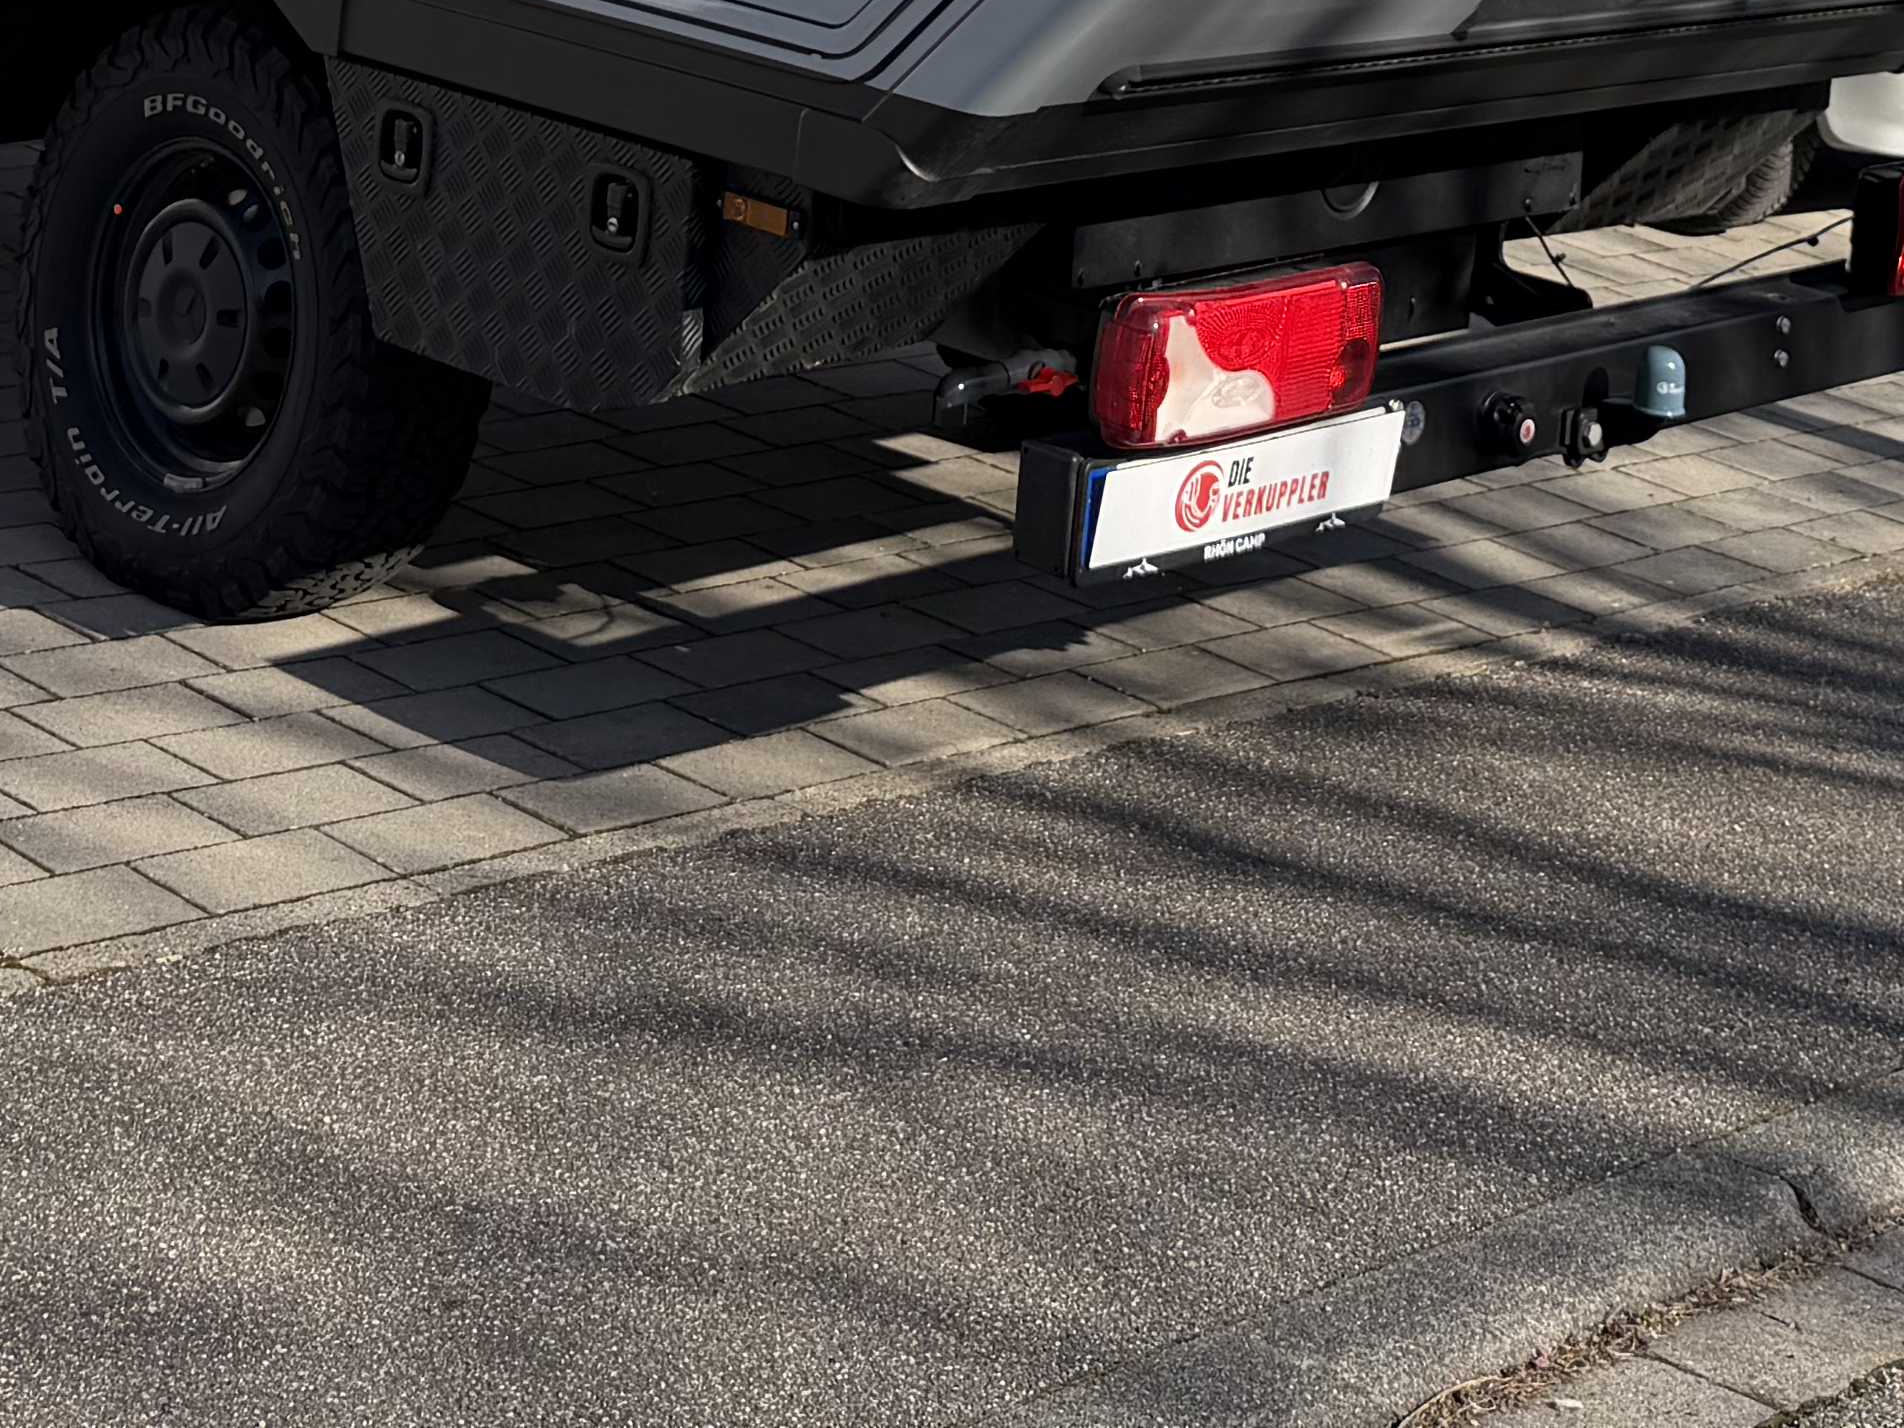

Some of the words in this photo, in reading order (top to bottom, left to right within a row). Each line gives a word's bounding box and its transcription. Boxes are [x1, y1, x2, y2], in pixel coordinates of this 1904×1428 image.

[143, 93, 301, 259] BFGoodrich
[43, 326, 69, 405] T/A
[1222, 470, 1329, 522] VERKUPPLER
[1228, 456, 1255, 487] DIE
[1203, 540, 1234, 560] RHÖN
[1235, 533, 1266, 552] CAMP
